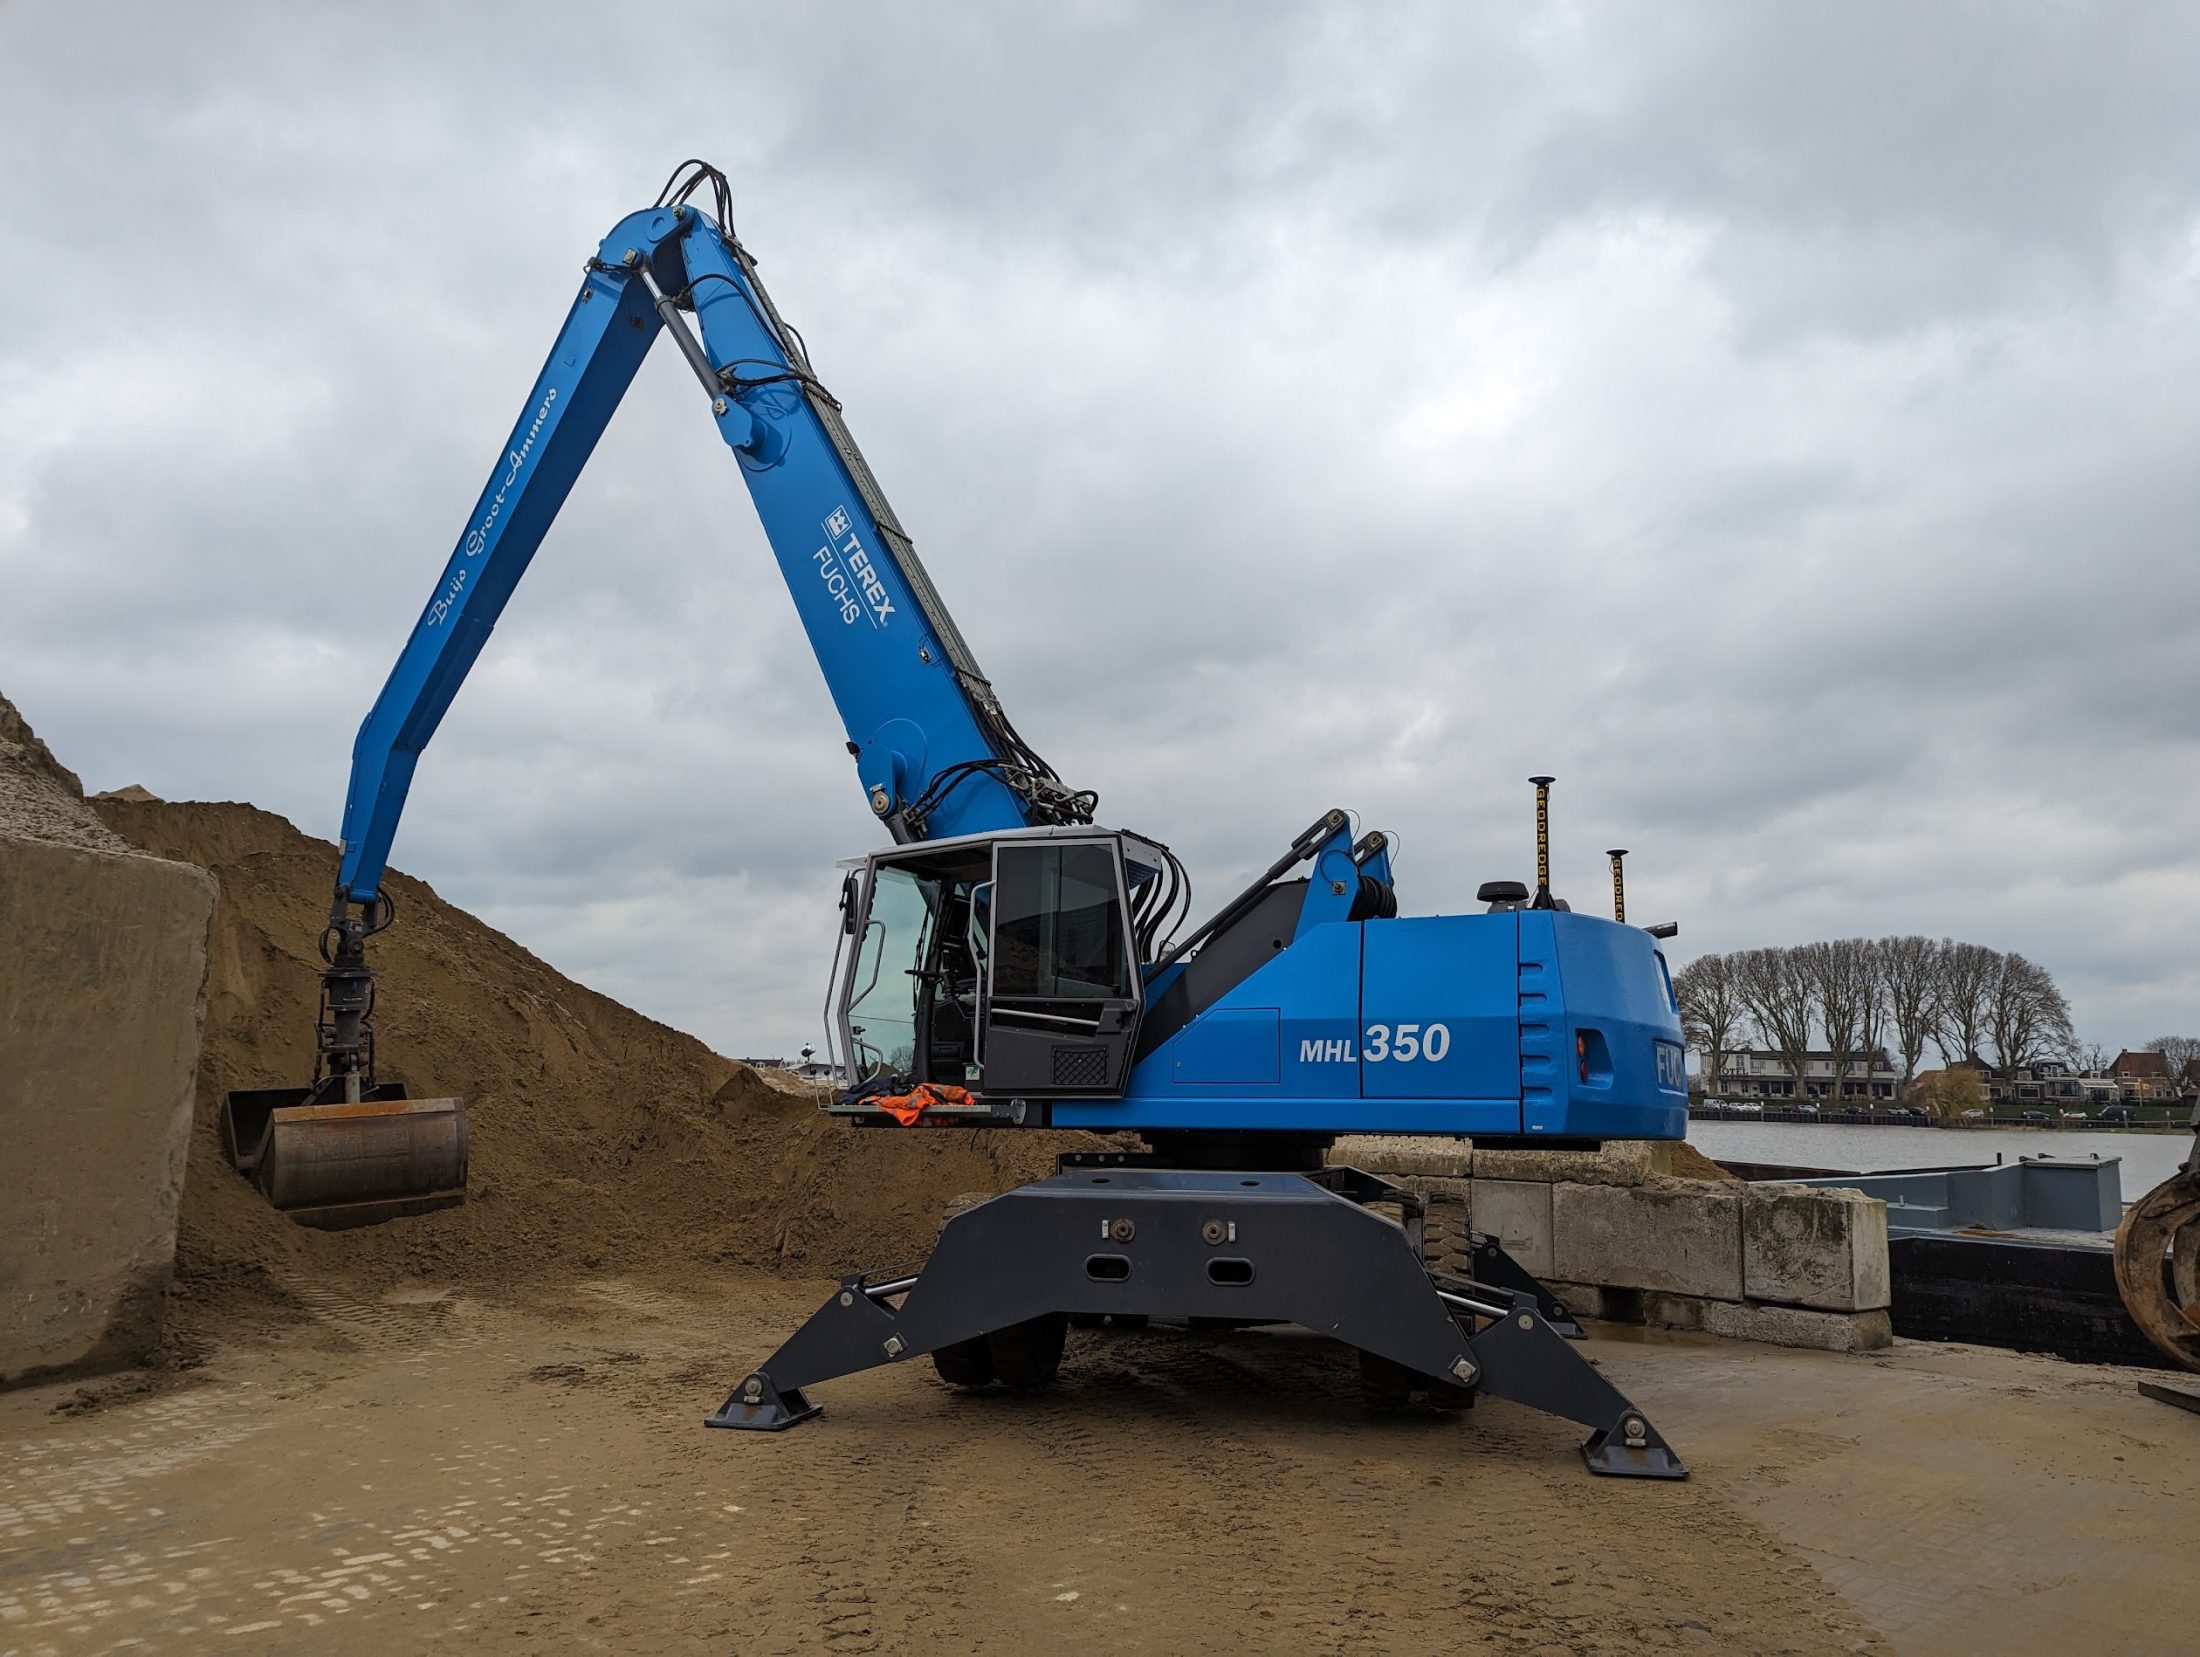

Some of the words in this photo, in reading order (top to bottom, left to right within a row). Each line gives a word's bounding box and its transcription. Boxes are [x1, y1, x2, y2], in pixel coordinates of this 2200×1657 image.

[427, 568, 466, 625] Buijs
[465, 388, 557, 557] Groot-Ammers
[812, 545, 860, 624] FUCHS
[842, 532, 896, 624] TEREX
[1537, 787, 1547, 886] GEODREDGE
[1300, 1039, 1357, 1063] MHL
[1363, 1023, 1450, 1062] 350
